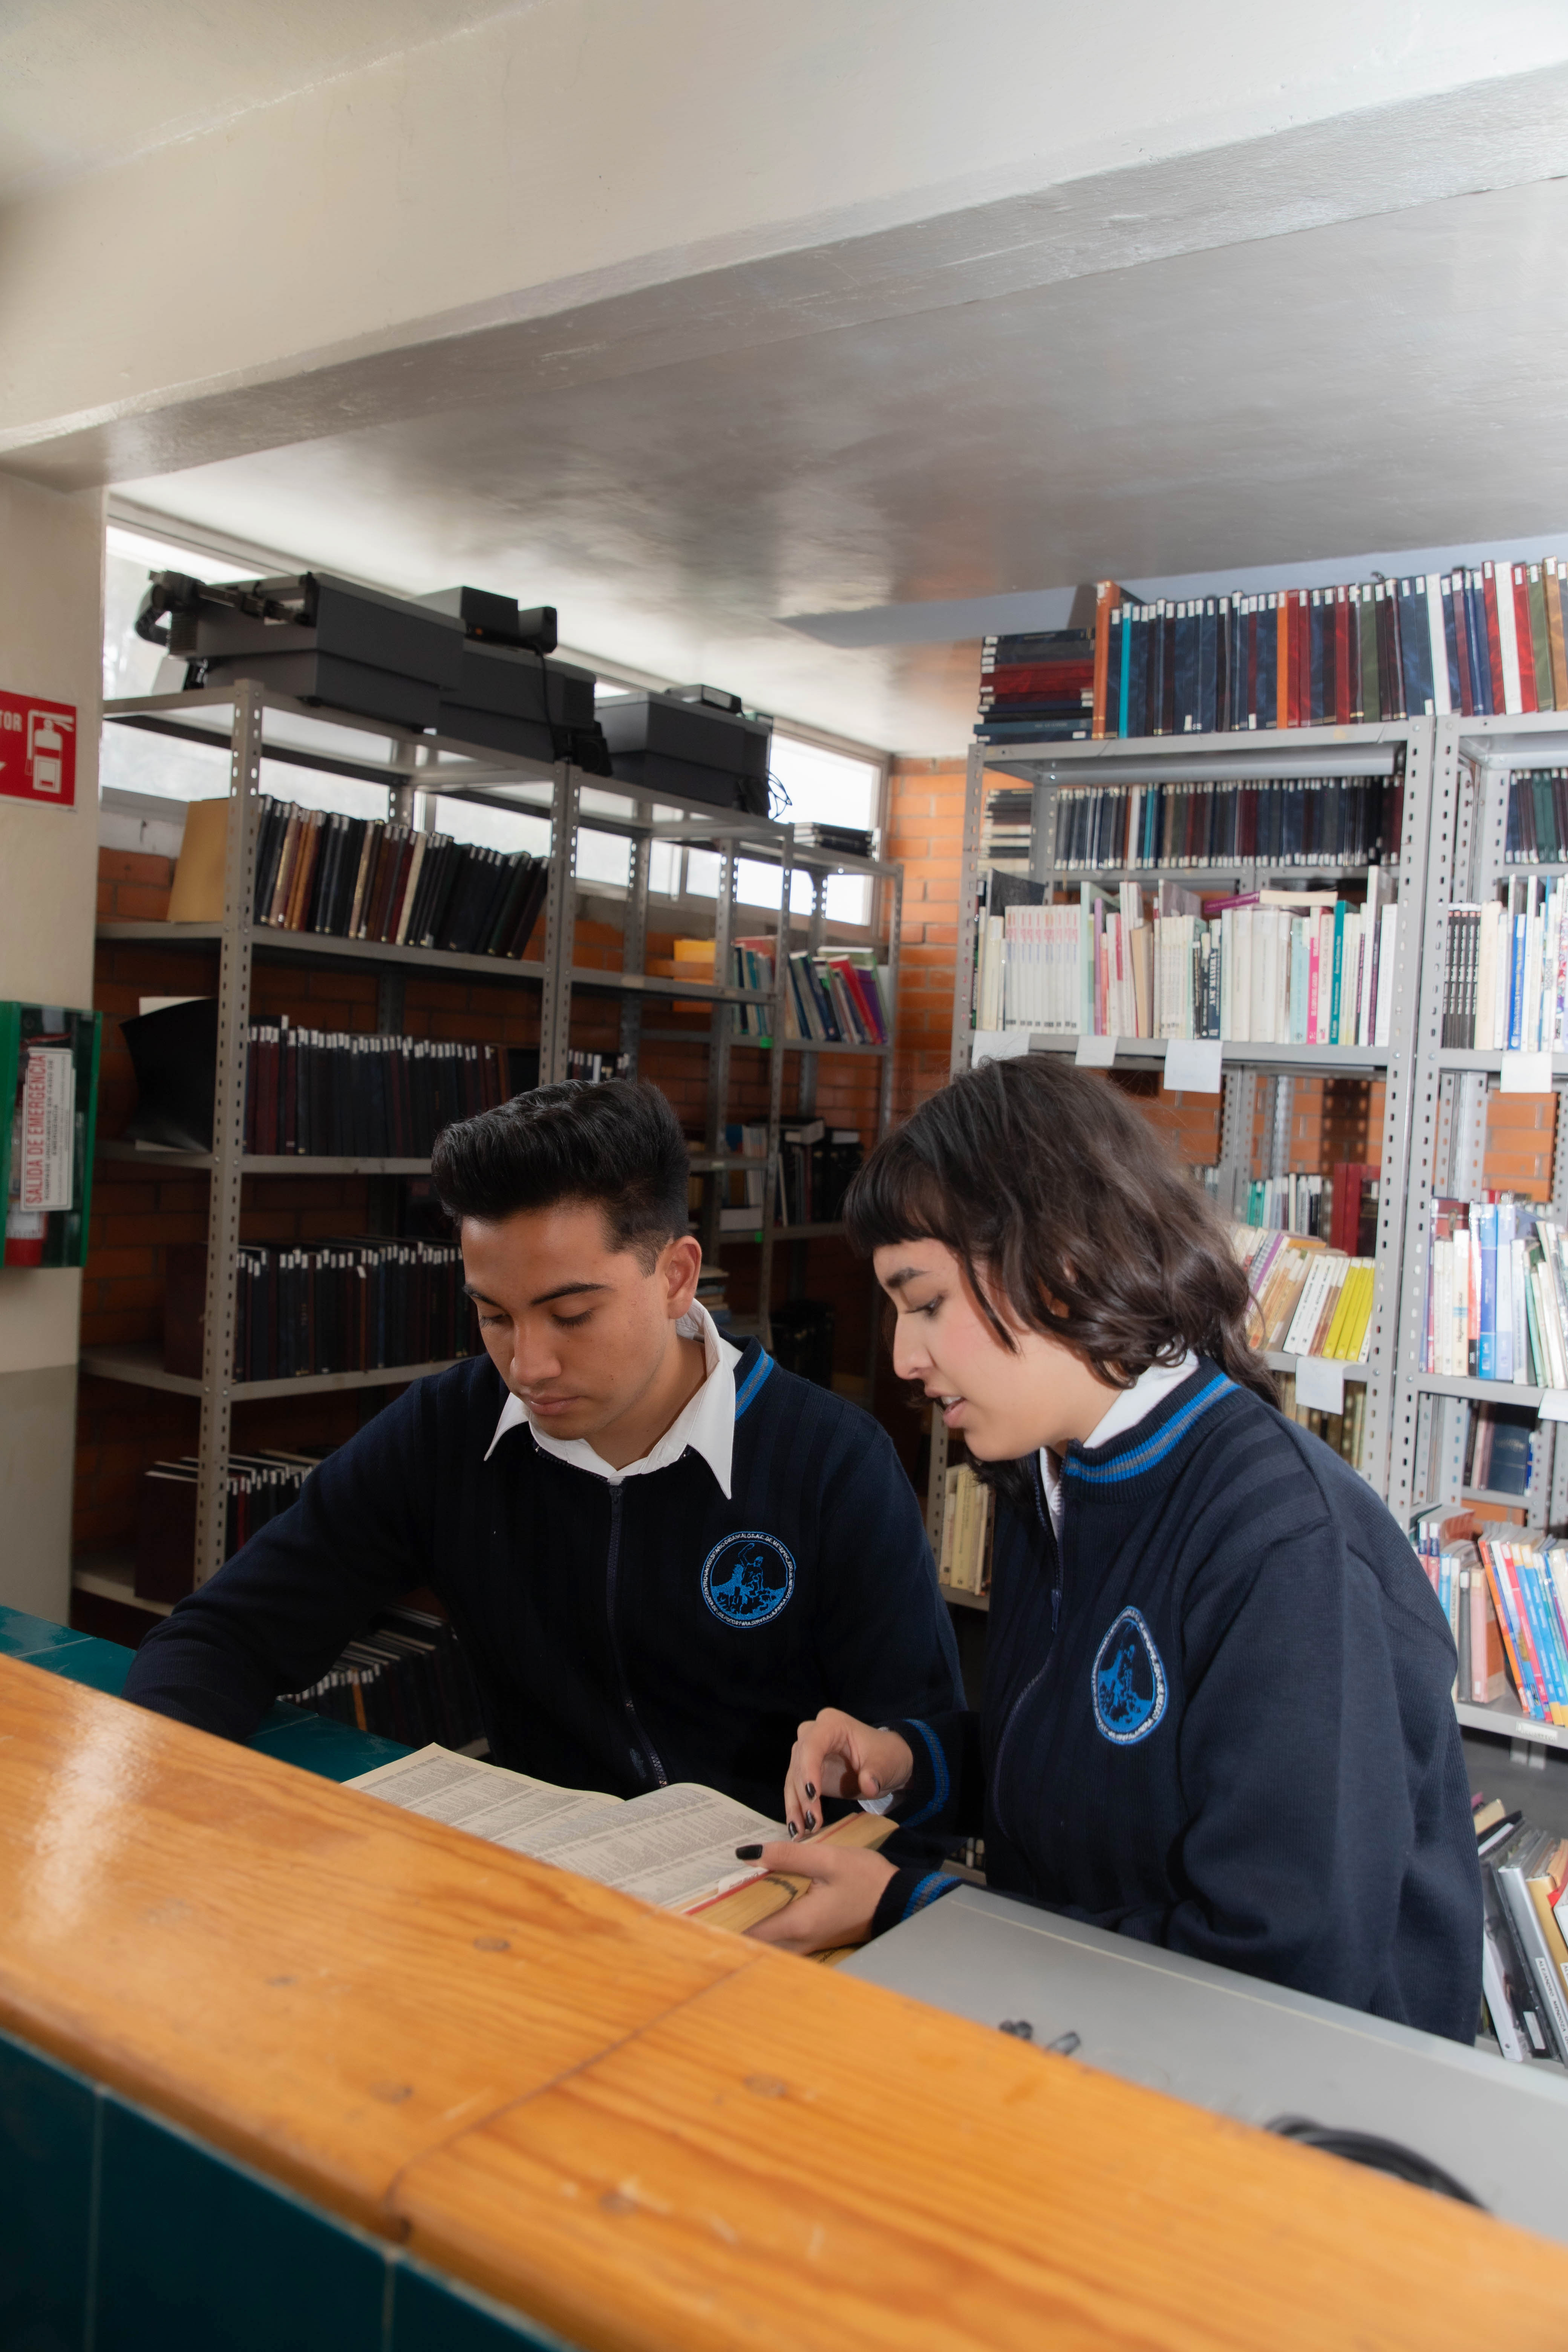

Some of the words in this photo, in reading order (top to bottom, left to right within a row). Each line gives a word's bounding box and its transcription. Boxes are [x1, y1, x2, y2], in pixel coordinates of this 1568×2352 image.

[28, 1055, 46, 1135] EMERGENCIA
[27, 1139, 44, 1156] DE
[25, 1159, 43, 1204] SALIDA
[703, 1542, 725, 1576] UNIVERSITARIO
[1539, 1961, 1554, 1997] ALEJANDRO
[1553, 2000, 1566, 2032] MENDOZA
